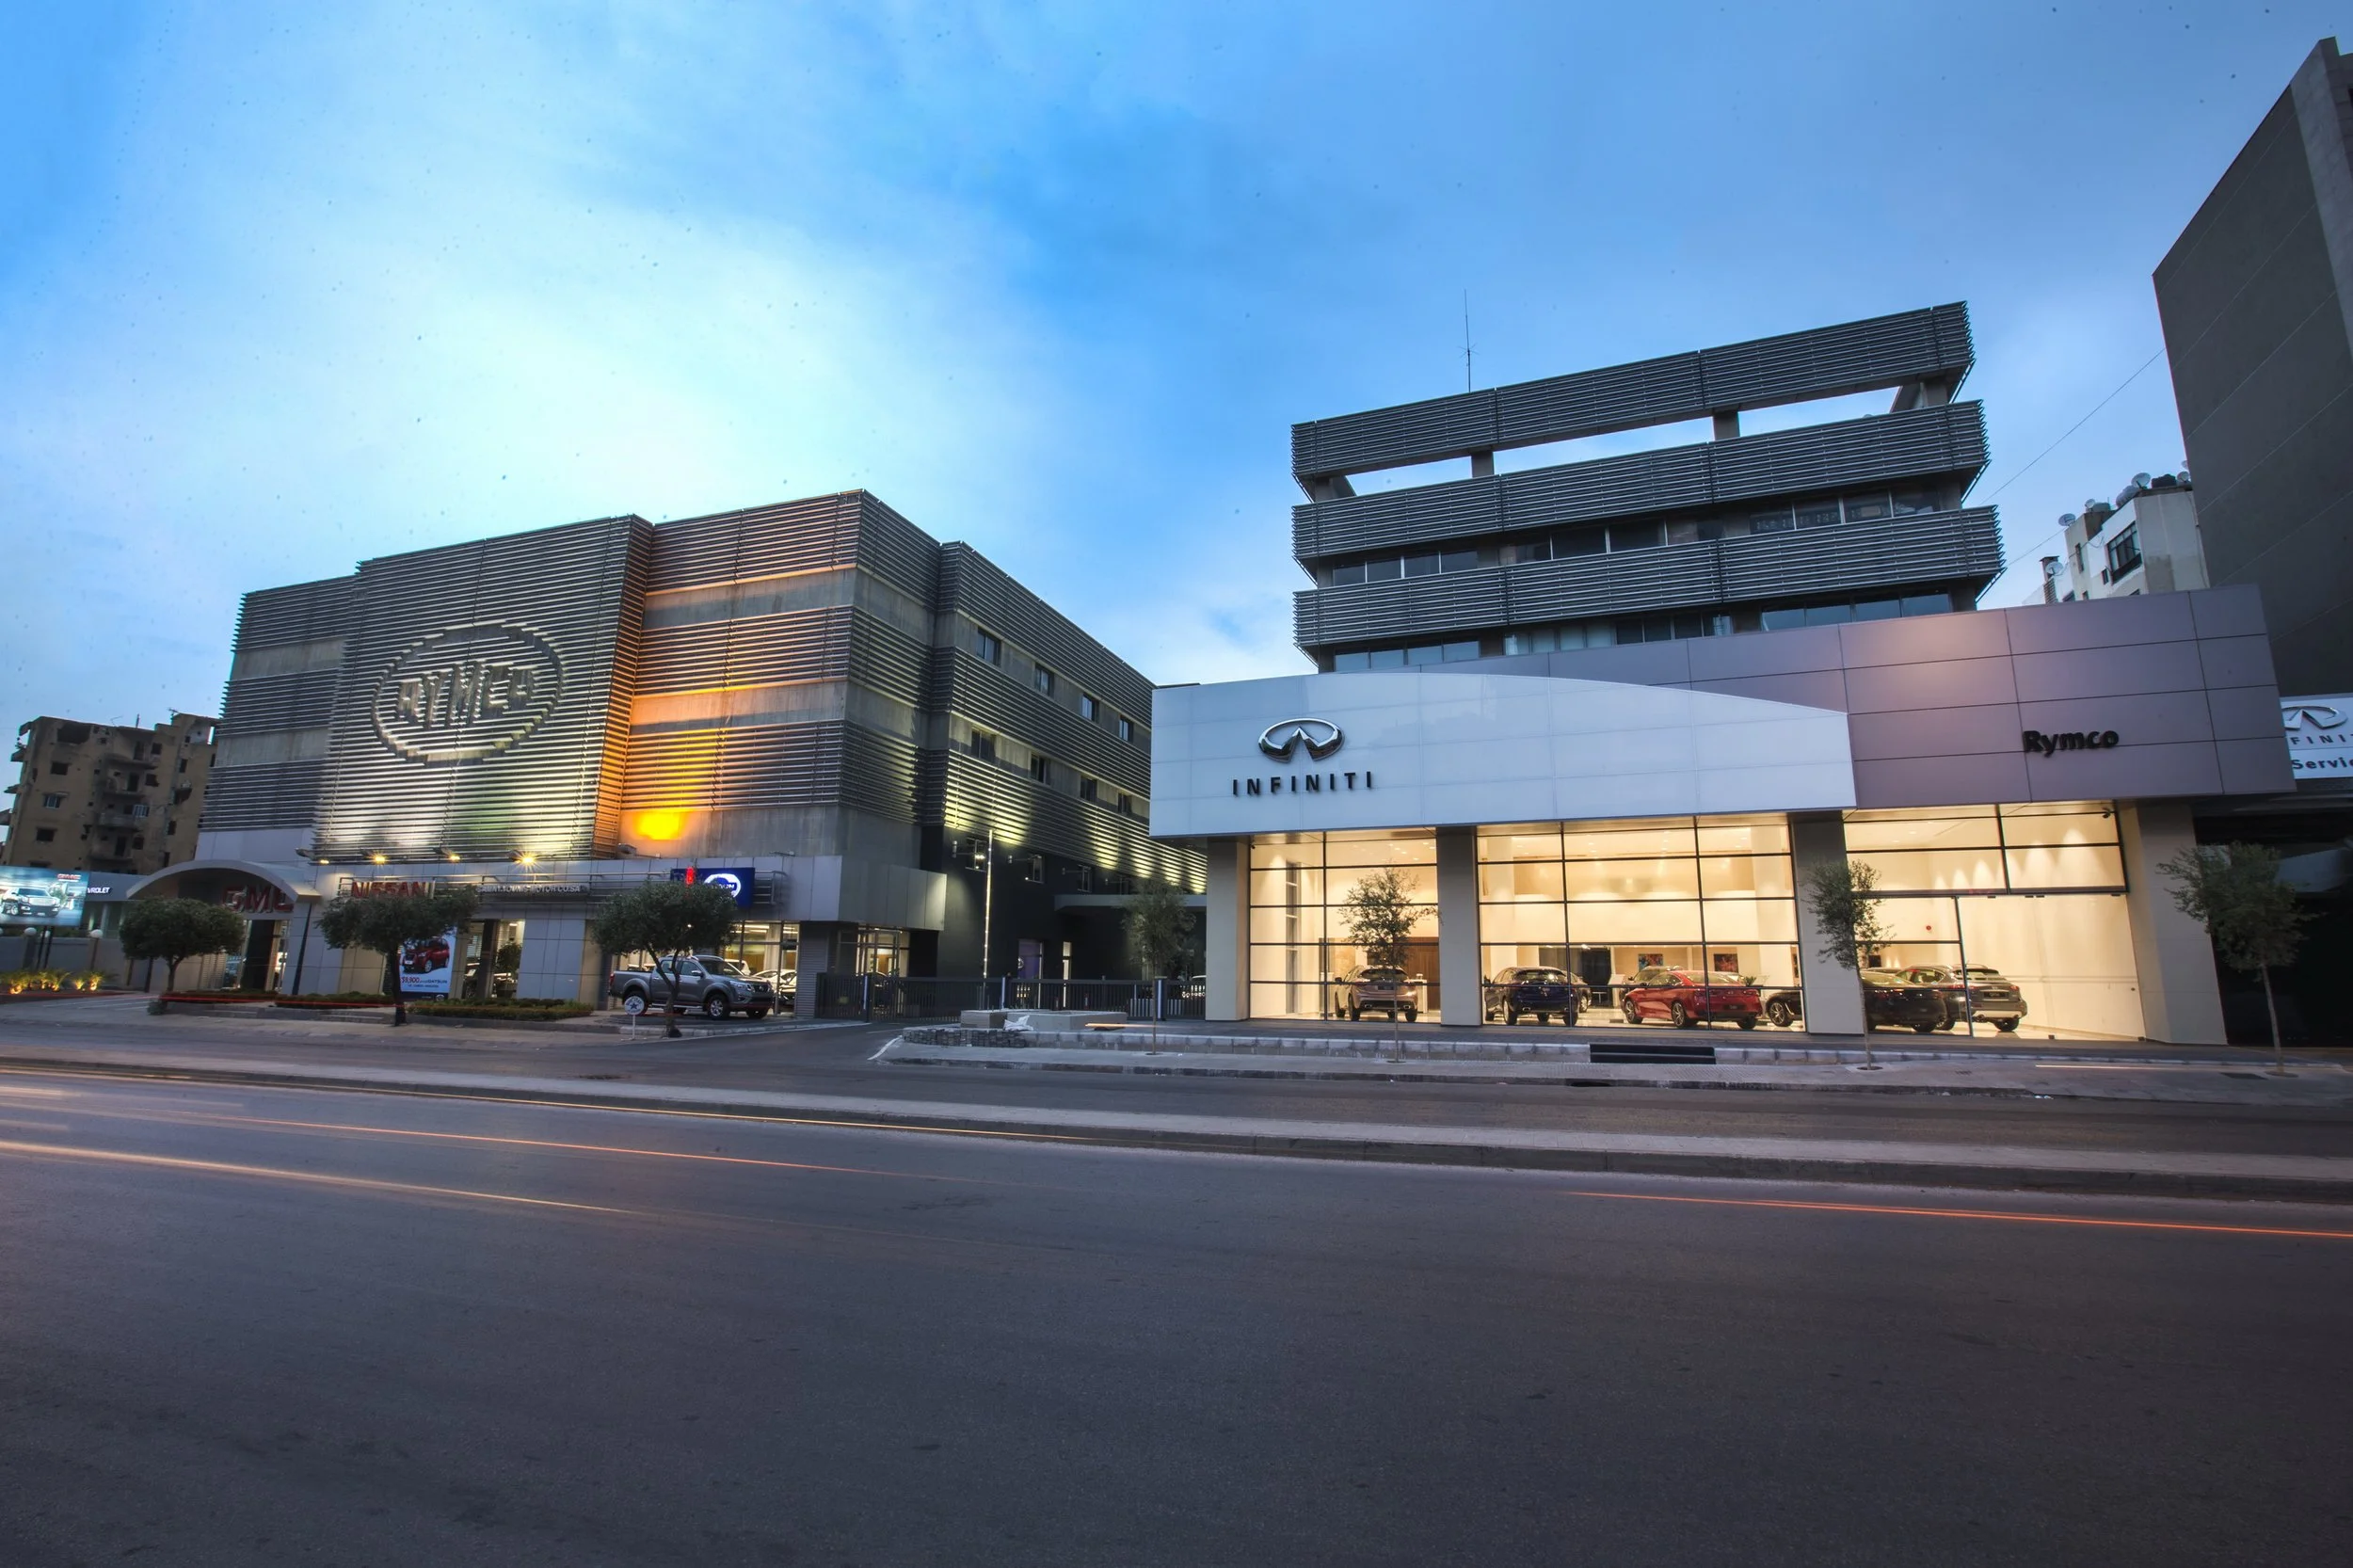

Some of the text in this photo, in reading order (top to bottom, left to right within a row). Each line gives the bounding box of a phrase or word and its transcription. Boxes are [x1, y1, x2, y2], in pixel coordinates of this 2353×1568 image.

[2024, 730, 2120, 758] Rymco
[2290, 733, 2353, 744] FINI
[1232, 771, 1372, 796] INFINITI
[351, 881, 429, 898] NISSAN
